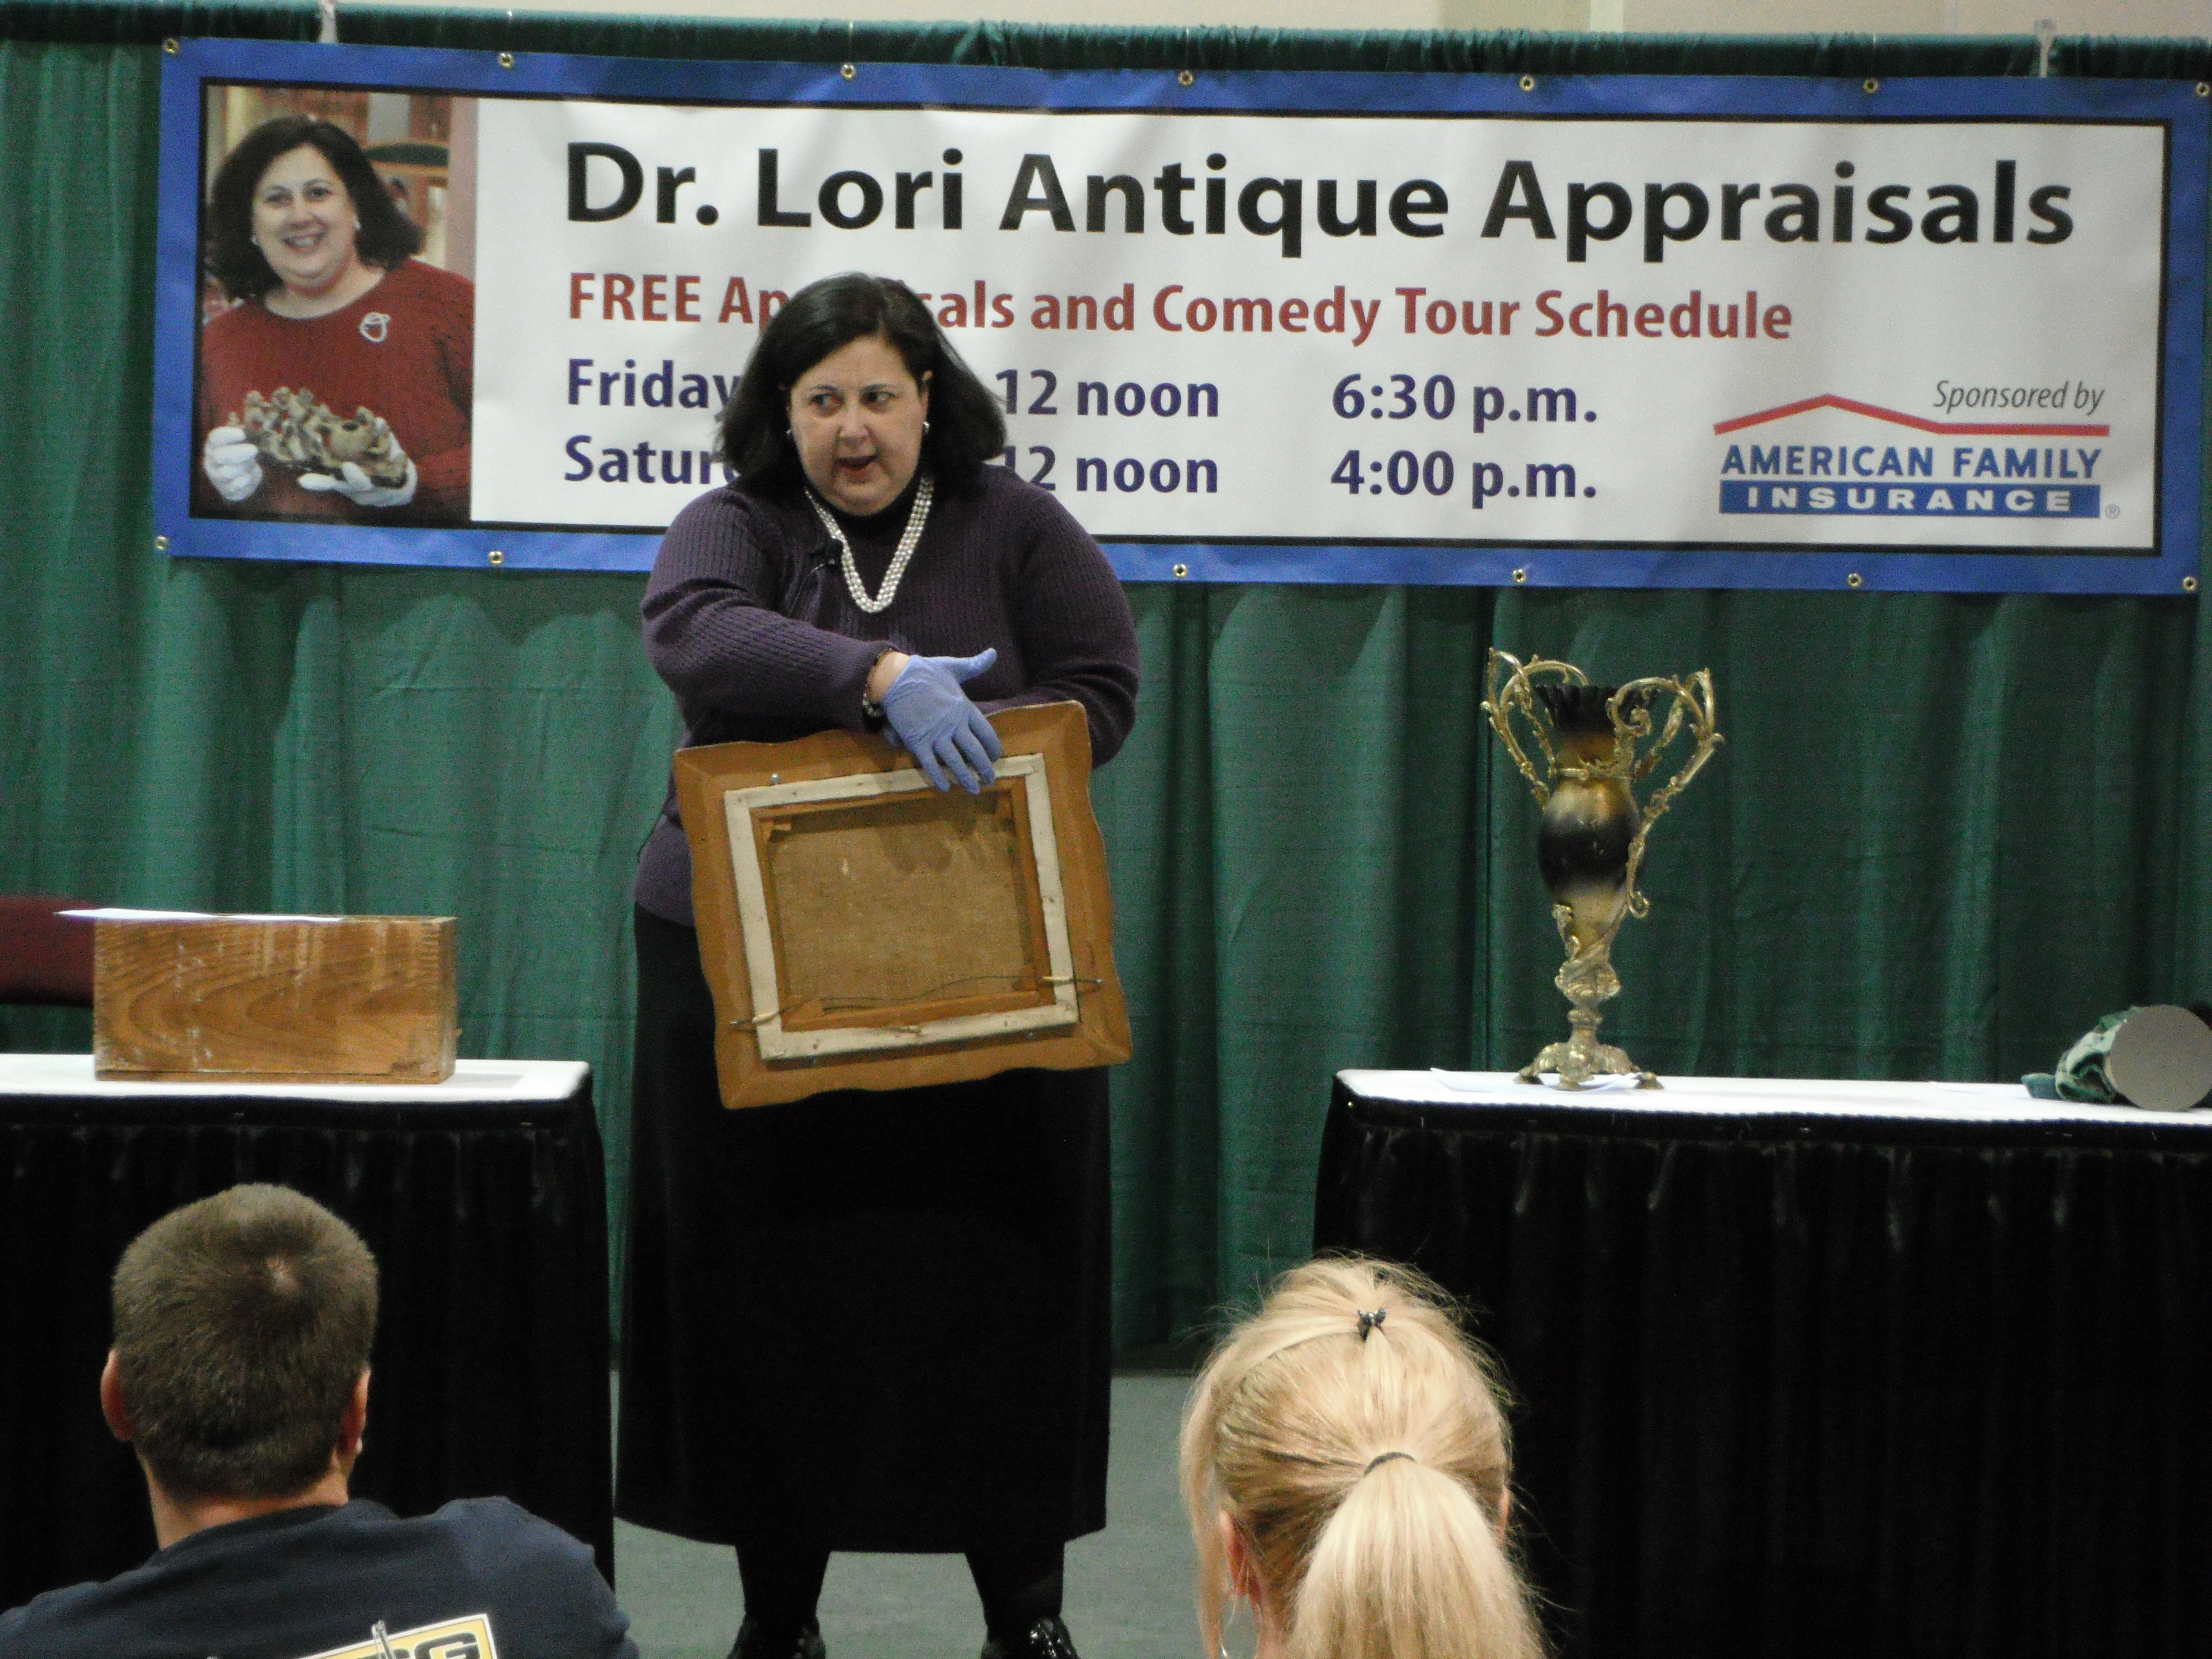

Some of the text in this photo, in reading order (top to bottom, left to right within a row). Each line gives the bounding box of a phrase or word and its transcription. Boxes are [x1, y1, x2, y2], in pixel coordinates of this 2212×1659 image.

[566, 141, 2074, 264] Dr. Lori Antique Appraisals
[569, 272, 1792, 348] FREE Apals and Comedy Tour Schedule
[567, 358, 1598, 434] Friday 12 noon 6:30 p.m.
[1933, 380, 2105, 416] Sponsored by
[564, 434, 740, 486] Satur
[1076, 457, 1219, 493] noon
[1330, 449, 1455, 497] 4:00
[1472, 462, 1597, 510] p.m.
[1721, 445, 2101, 479] AMERICAN FAMILY
[1747, 487, 2072, 512] INSURANCE
